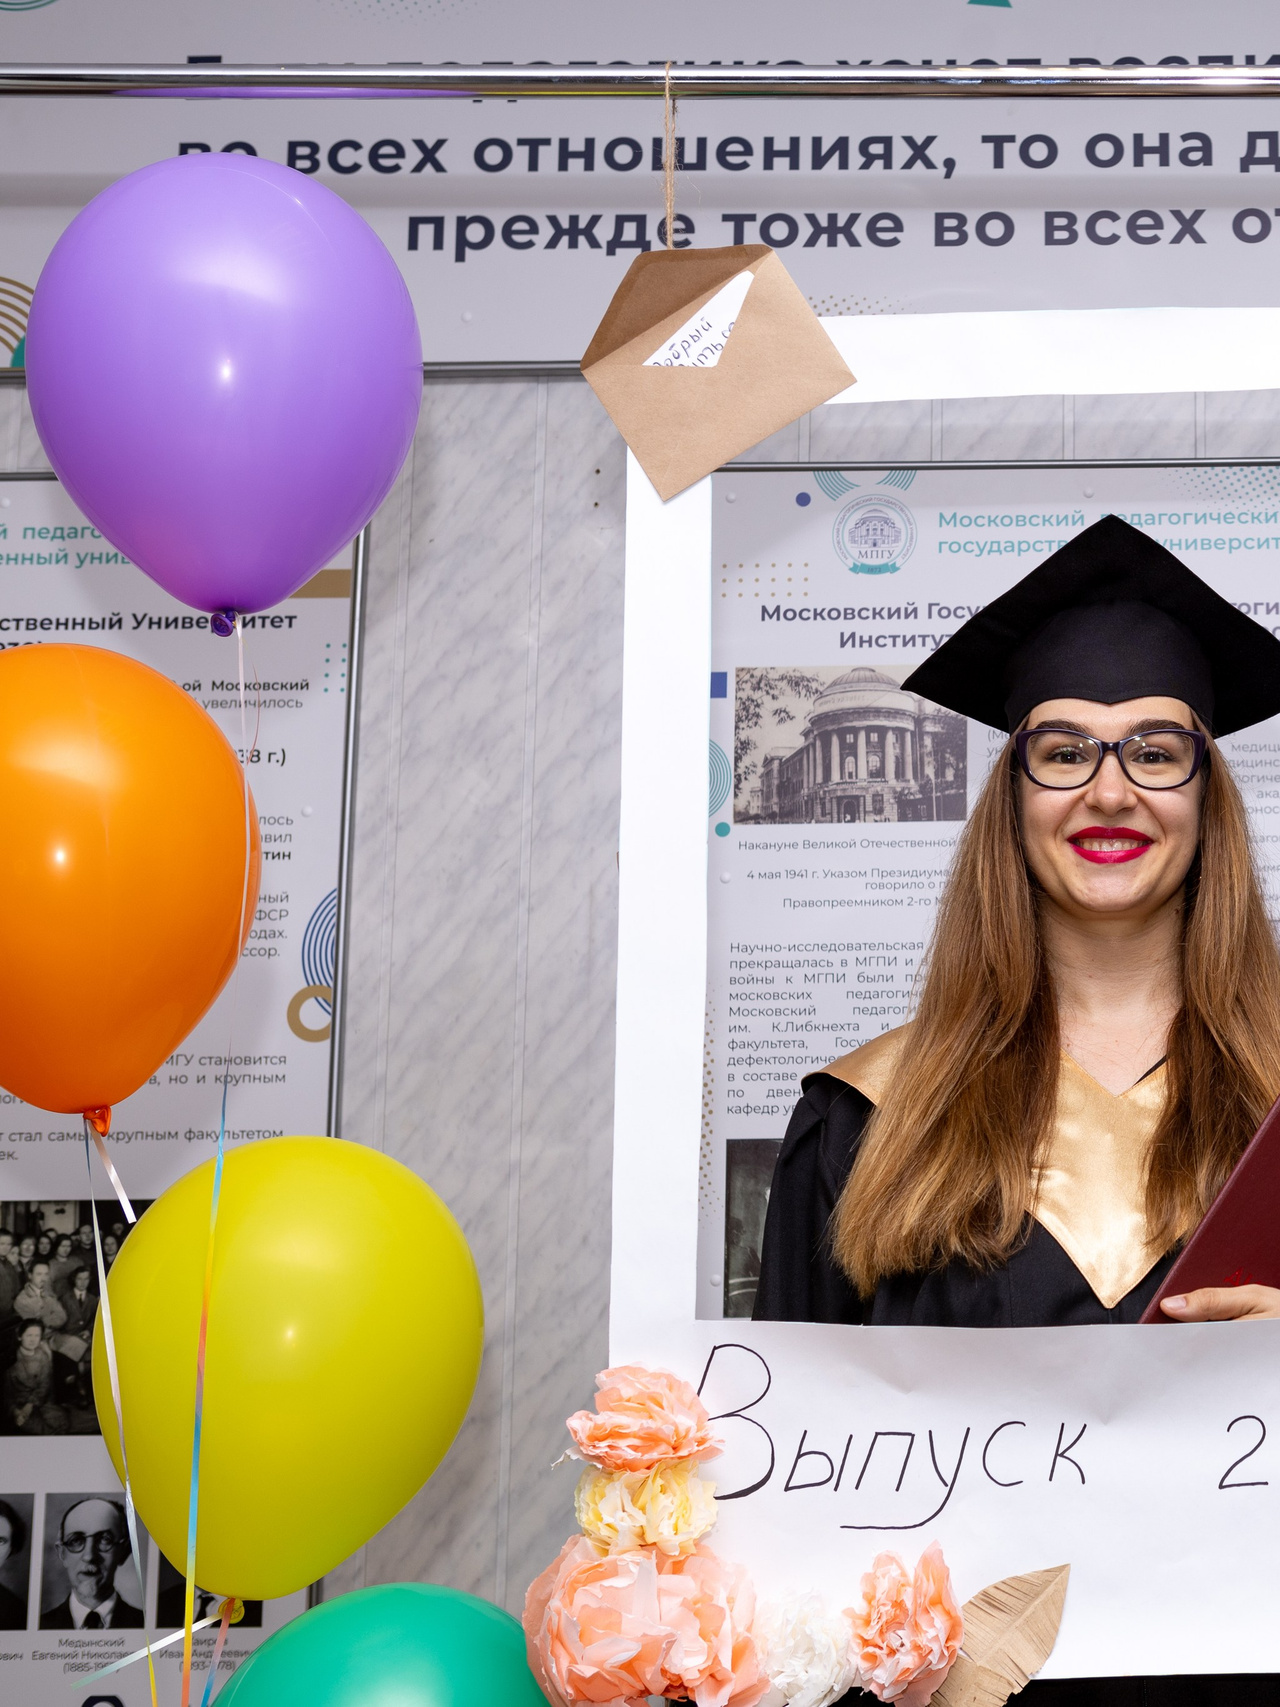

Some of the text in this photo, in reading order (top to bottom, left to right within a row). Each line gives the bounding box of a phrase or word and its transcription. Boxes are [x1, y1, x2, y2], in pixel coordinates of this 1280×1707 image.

[287, 139, 448, 174] всех
[473, 131, 957, 180] отношениях,
[981, 134, 1058, 169] то
[1085, 132, 1212, 168] она
[407, 213, 697, 263] прежде
[722, 212, 905, 249] тоже
[935, 211, 1015, 246] во
[1045, 209, 1207, 245] всех
[939, 510, 1084, 527] Московский
[858, 550, 894, 559] МПГУ
[938, 539, 1068, 557] государств
[761, 602, 917, 621] Московский
[0, 612, 297, 632] ственный Унивеитет
[839, 631, 953, 651] Институ
[268, 749, 285, 766] г.)
[739, 841, 798, 852] Накануне
[803, 839, 856, 849] Великой
[785, 870, 807, 879] 1941
[823, 869, 867, 878] Указом
[866, 882, 924, 891] говорило
[783, 896, 931, 909] Правопреемником 2-го
[731, 942, 923, 955] Научно-исследовательская
[730, 956, 897, 971] прекращалась МГПИ
[730, 972, 893, 985] войны МГПИ были
[730, 992, 812, 1001] московских
[729, 1005, 816, 1017] Московский
[773, 1021, 859, 1032] К.Либкнехта
[728, 1039, 808, 1051] факультета,
[169, 1075, 188, 1084] но
[743, 1073, 797, 1081] составе
[728, 1090, 744, 1098] по
[727, 1103, 779, 1116] кафедр
[8, 1132, 42, 1142] стал
[107, 1131, 178, 1144] крупным
[697, 1343, 1086, 1530] Выпуск
[59, 1638, 125, 1648] Медынский
[32, 1650, 79, 1660] Евгений
